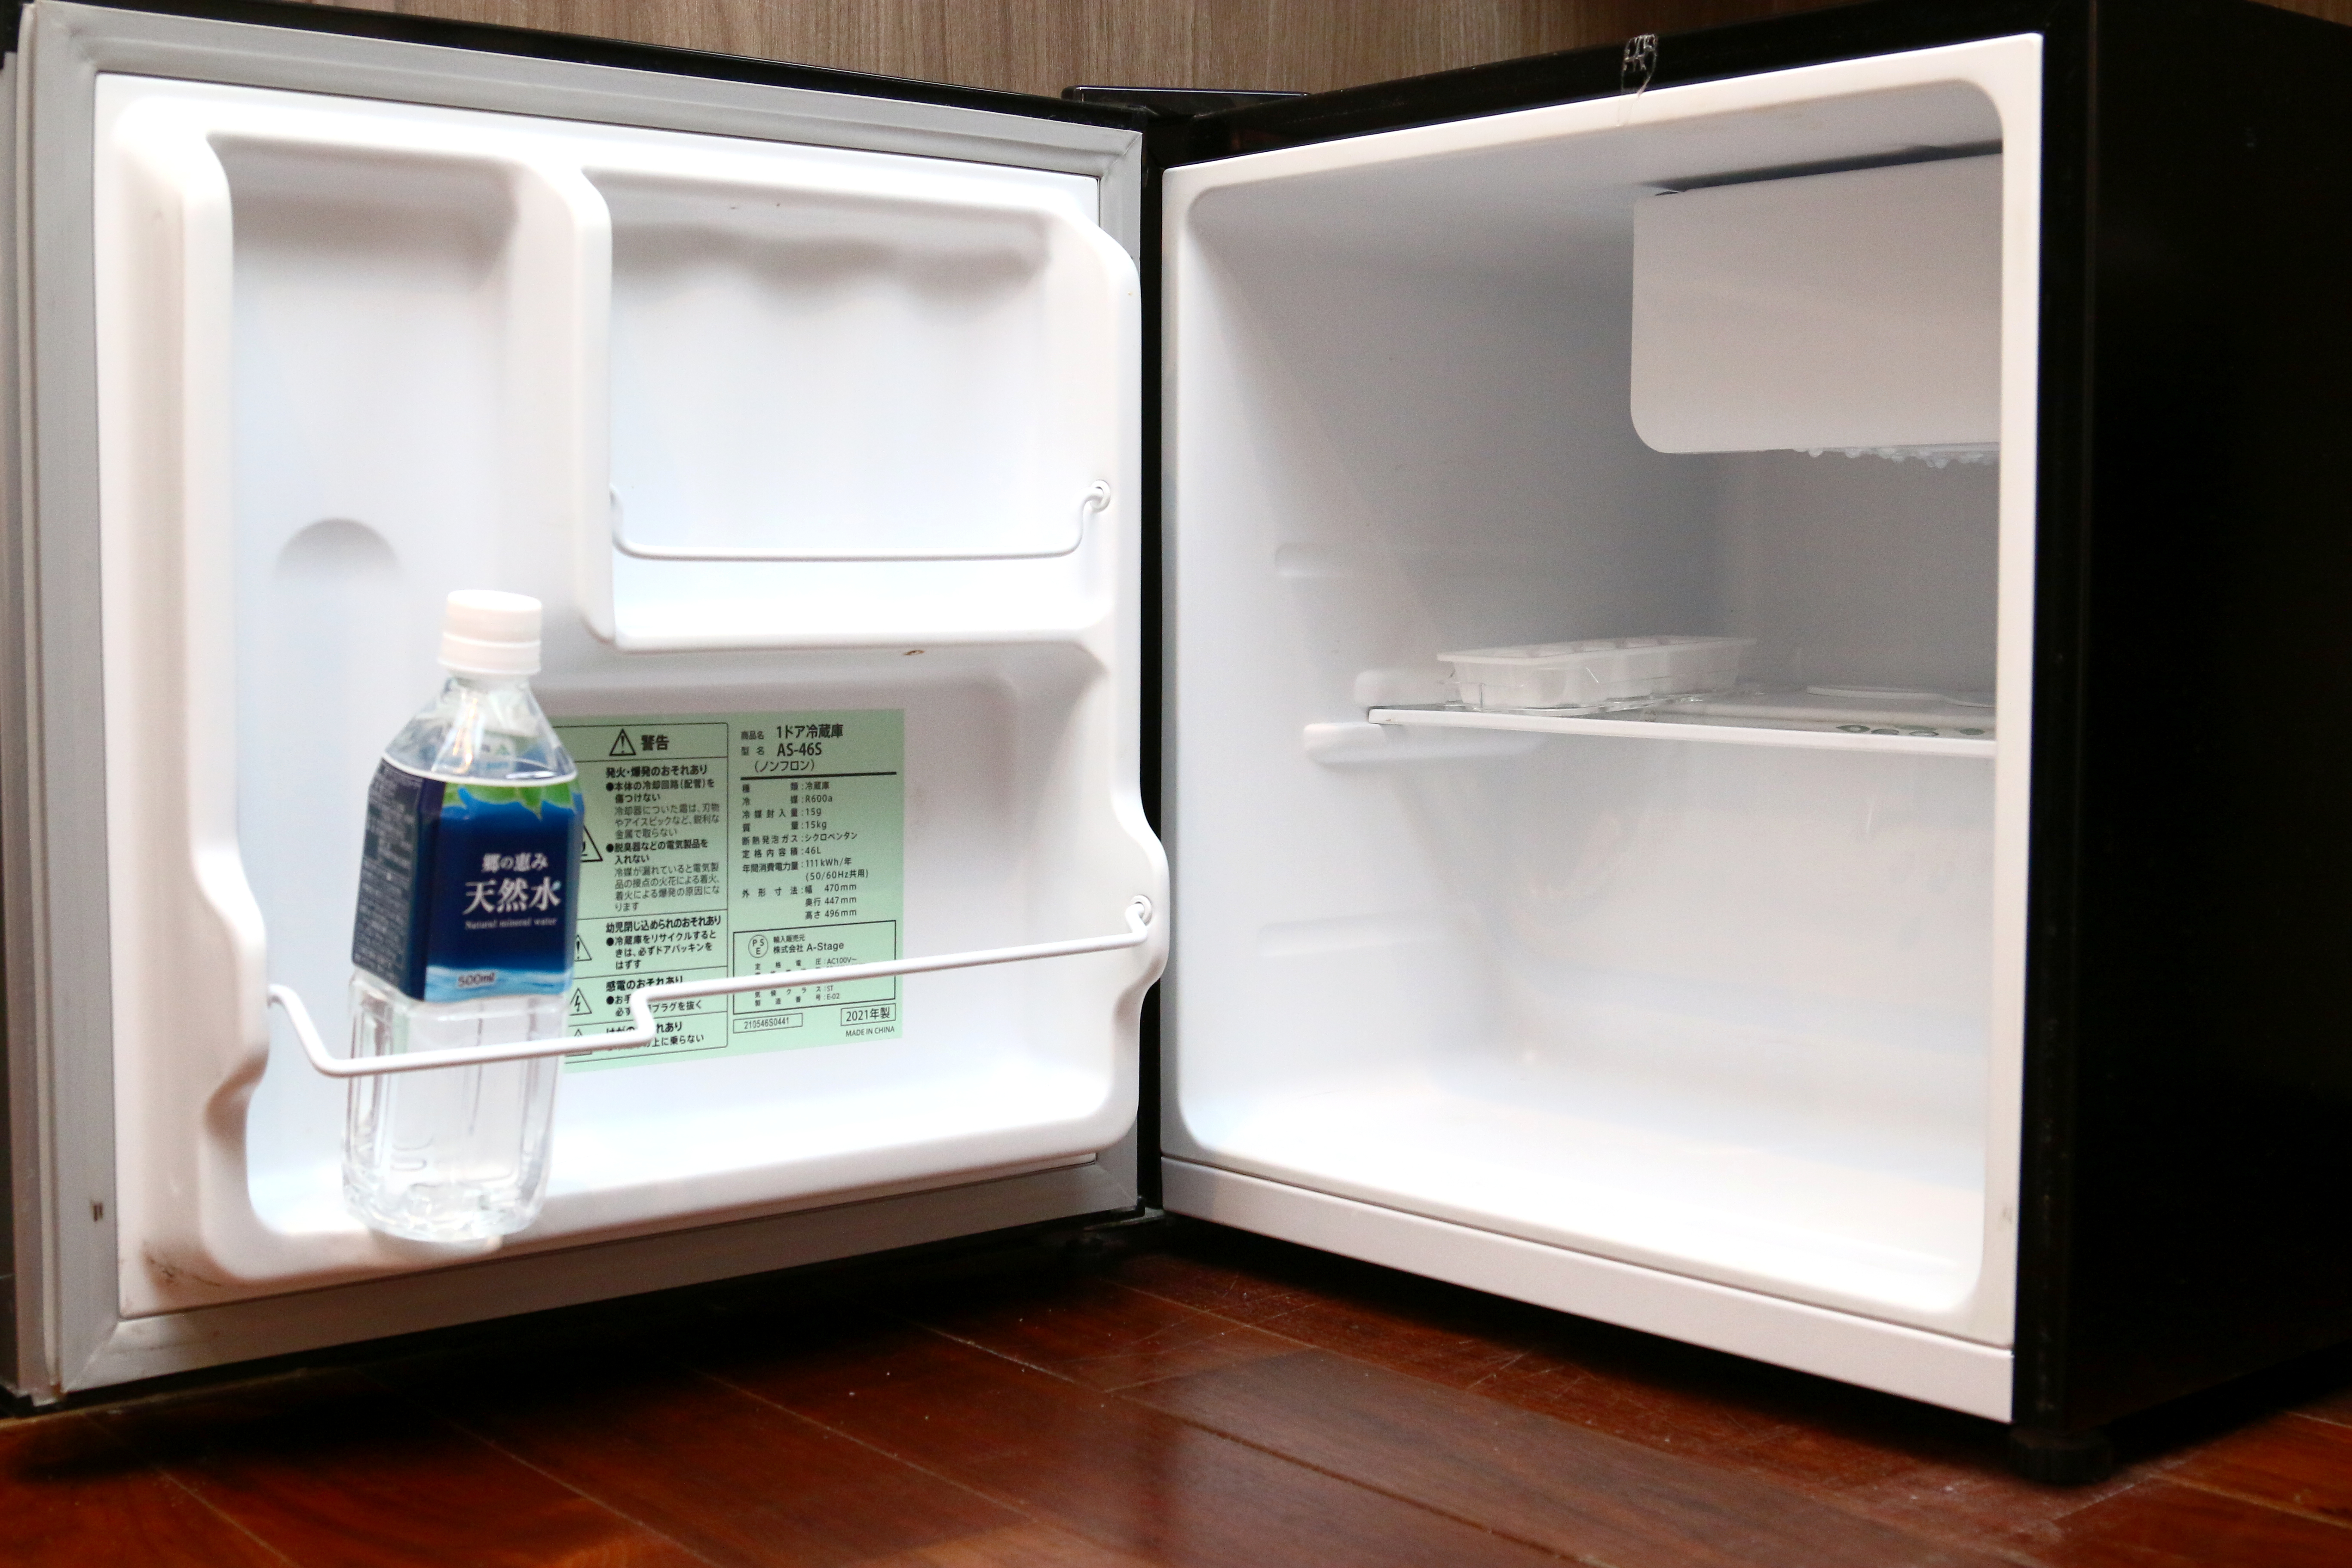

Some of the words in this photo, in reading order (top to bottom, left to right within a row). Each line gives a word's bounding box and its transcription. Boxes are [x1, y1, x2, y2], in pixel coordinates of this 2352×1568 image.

[741, 731, 764, 740] 商品名
[776, 723, 844, 738] 1ドア冷蔵庫
[641, 735, 669, 751] 警告
[777, 742, 822, 756] AS-46S
[481, 852, 549, 873] 郷の恵み
[615, 854, 649, 864] 入れない
[824, 884, 857, 892] 470mm
[462, 876, 561, 916] 天然水
[805, 897, 821, 907] 奥行
[824, 896, 857, 905] 447mm
[615, 902, 639, 912] ります
[805, 911, 821, 920] 高さ
[825, 909, 857, 918] 496mm
[465, 919, 498, 930] Natural
[534, 918, 557, 926] water
[773, 944, 803, 954] 株式会社
[806, 942, 844, 952] A-Stage
[616, 959, 641, 970] はずす
[846, 1007, 890, 1022] 2021年製
[874, 1026, 894, 1034] CHINA
